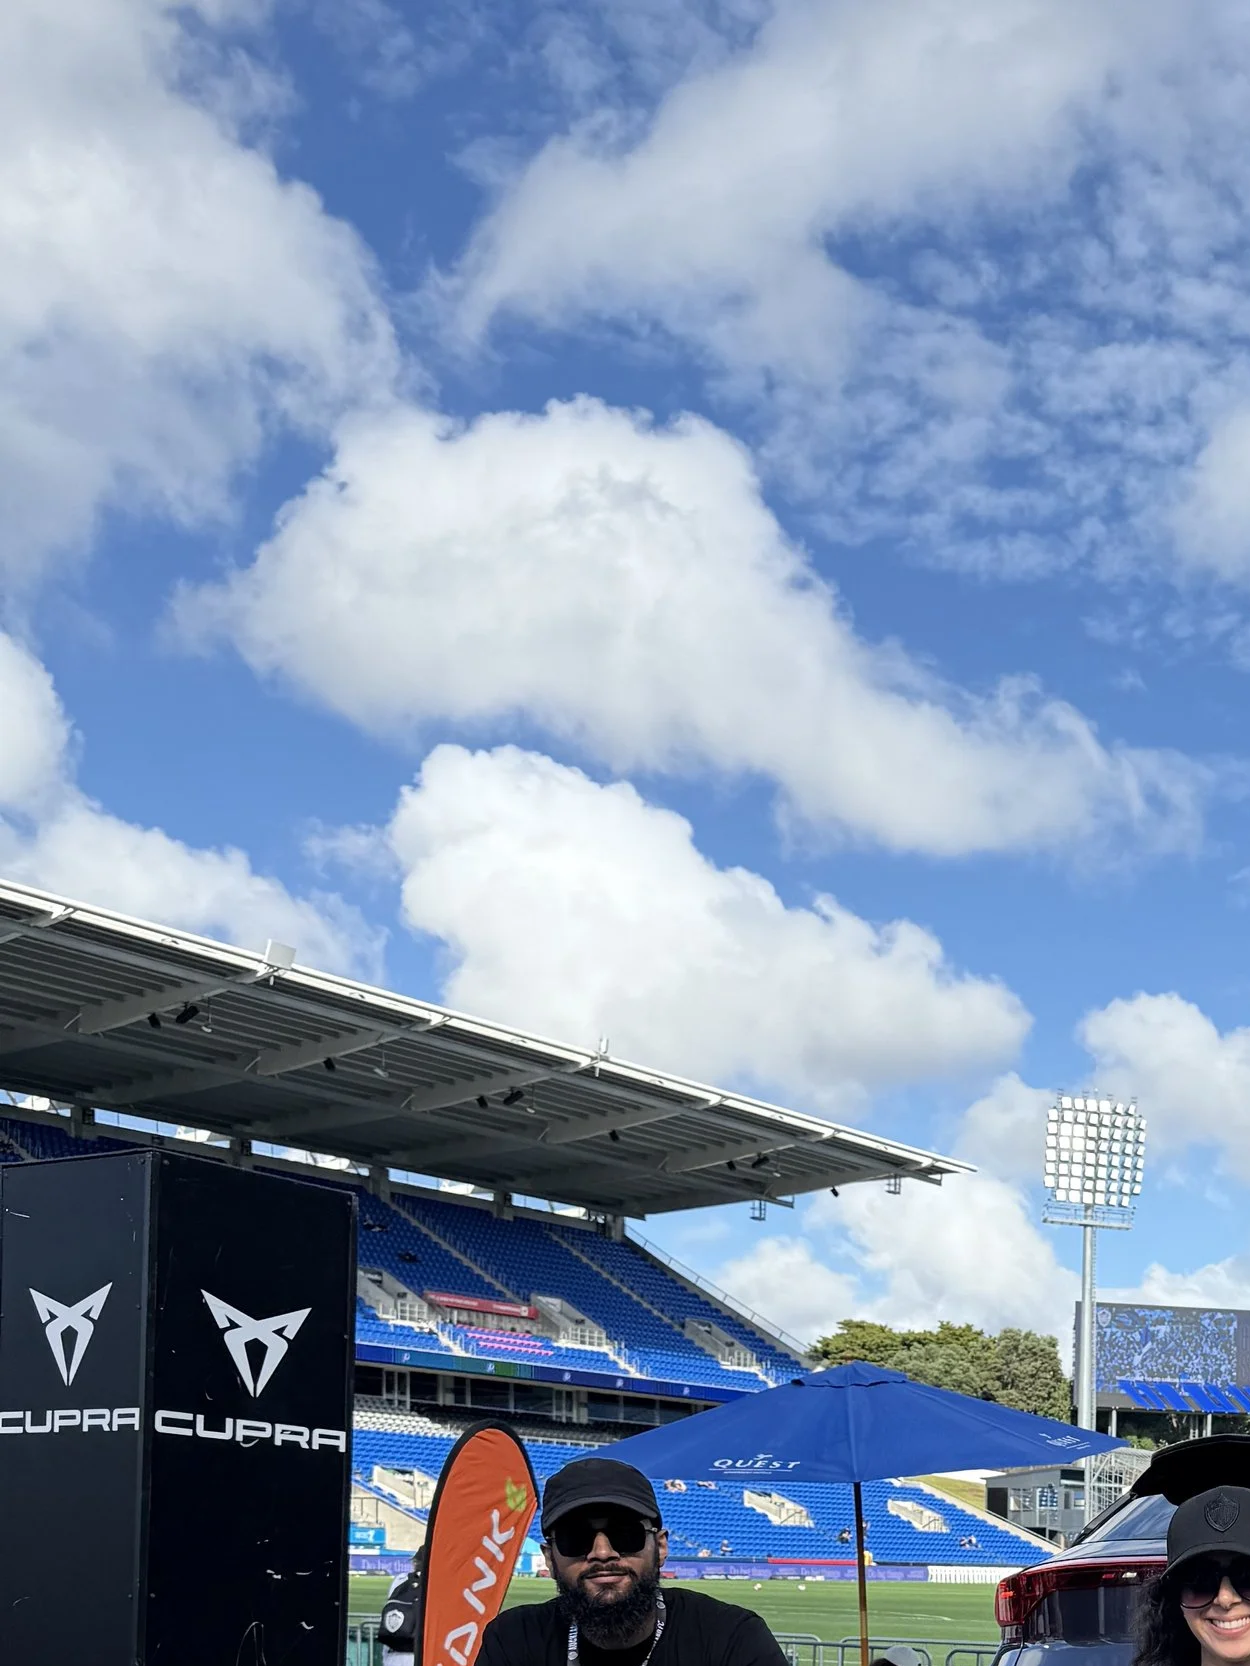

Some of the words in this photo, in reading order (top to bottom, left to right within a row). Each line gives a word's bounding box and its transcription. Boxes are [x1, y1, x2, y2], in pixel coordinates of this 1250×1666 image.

[0, 1408, 139, 1433] CUPRA
[155, 1410, 346, 1452] CUPRA
[713, 1458, 801, 1469] QUEST
